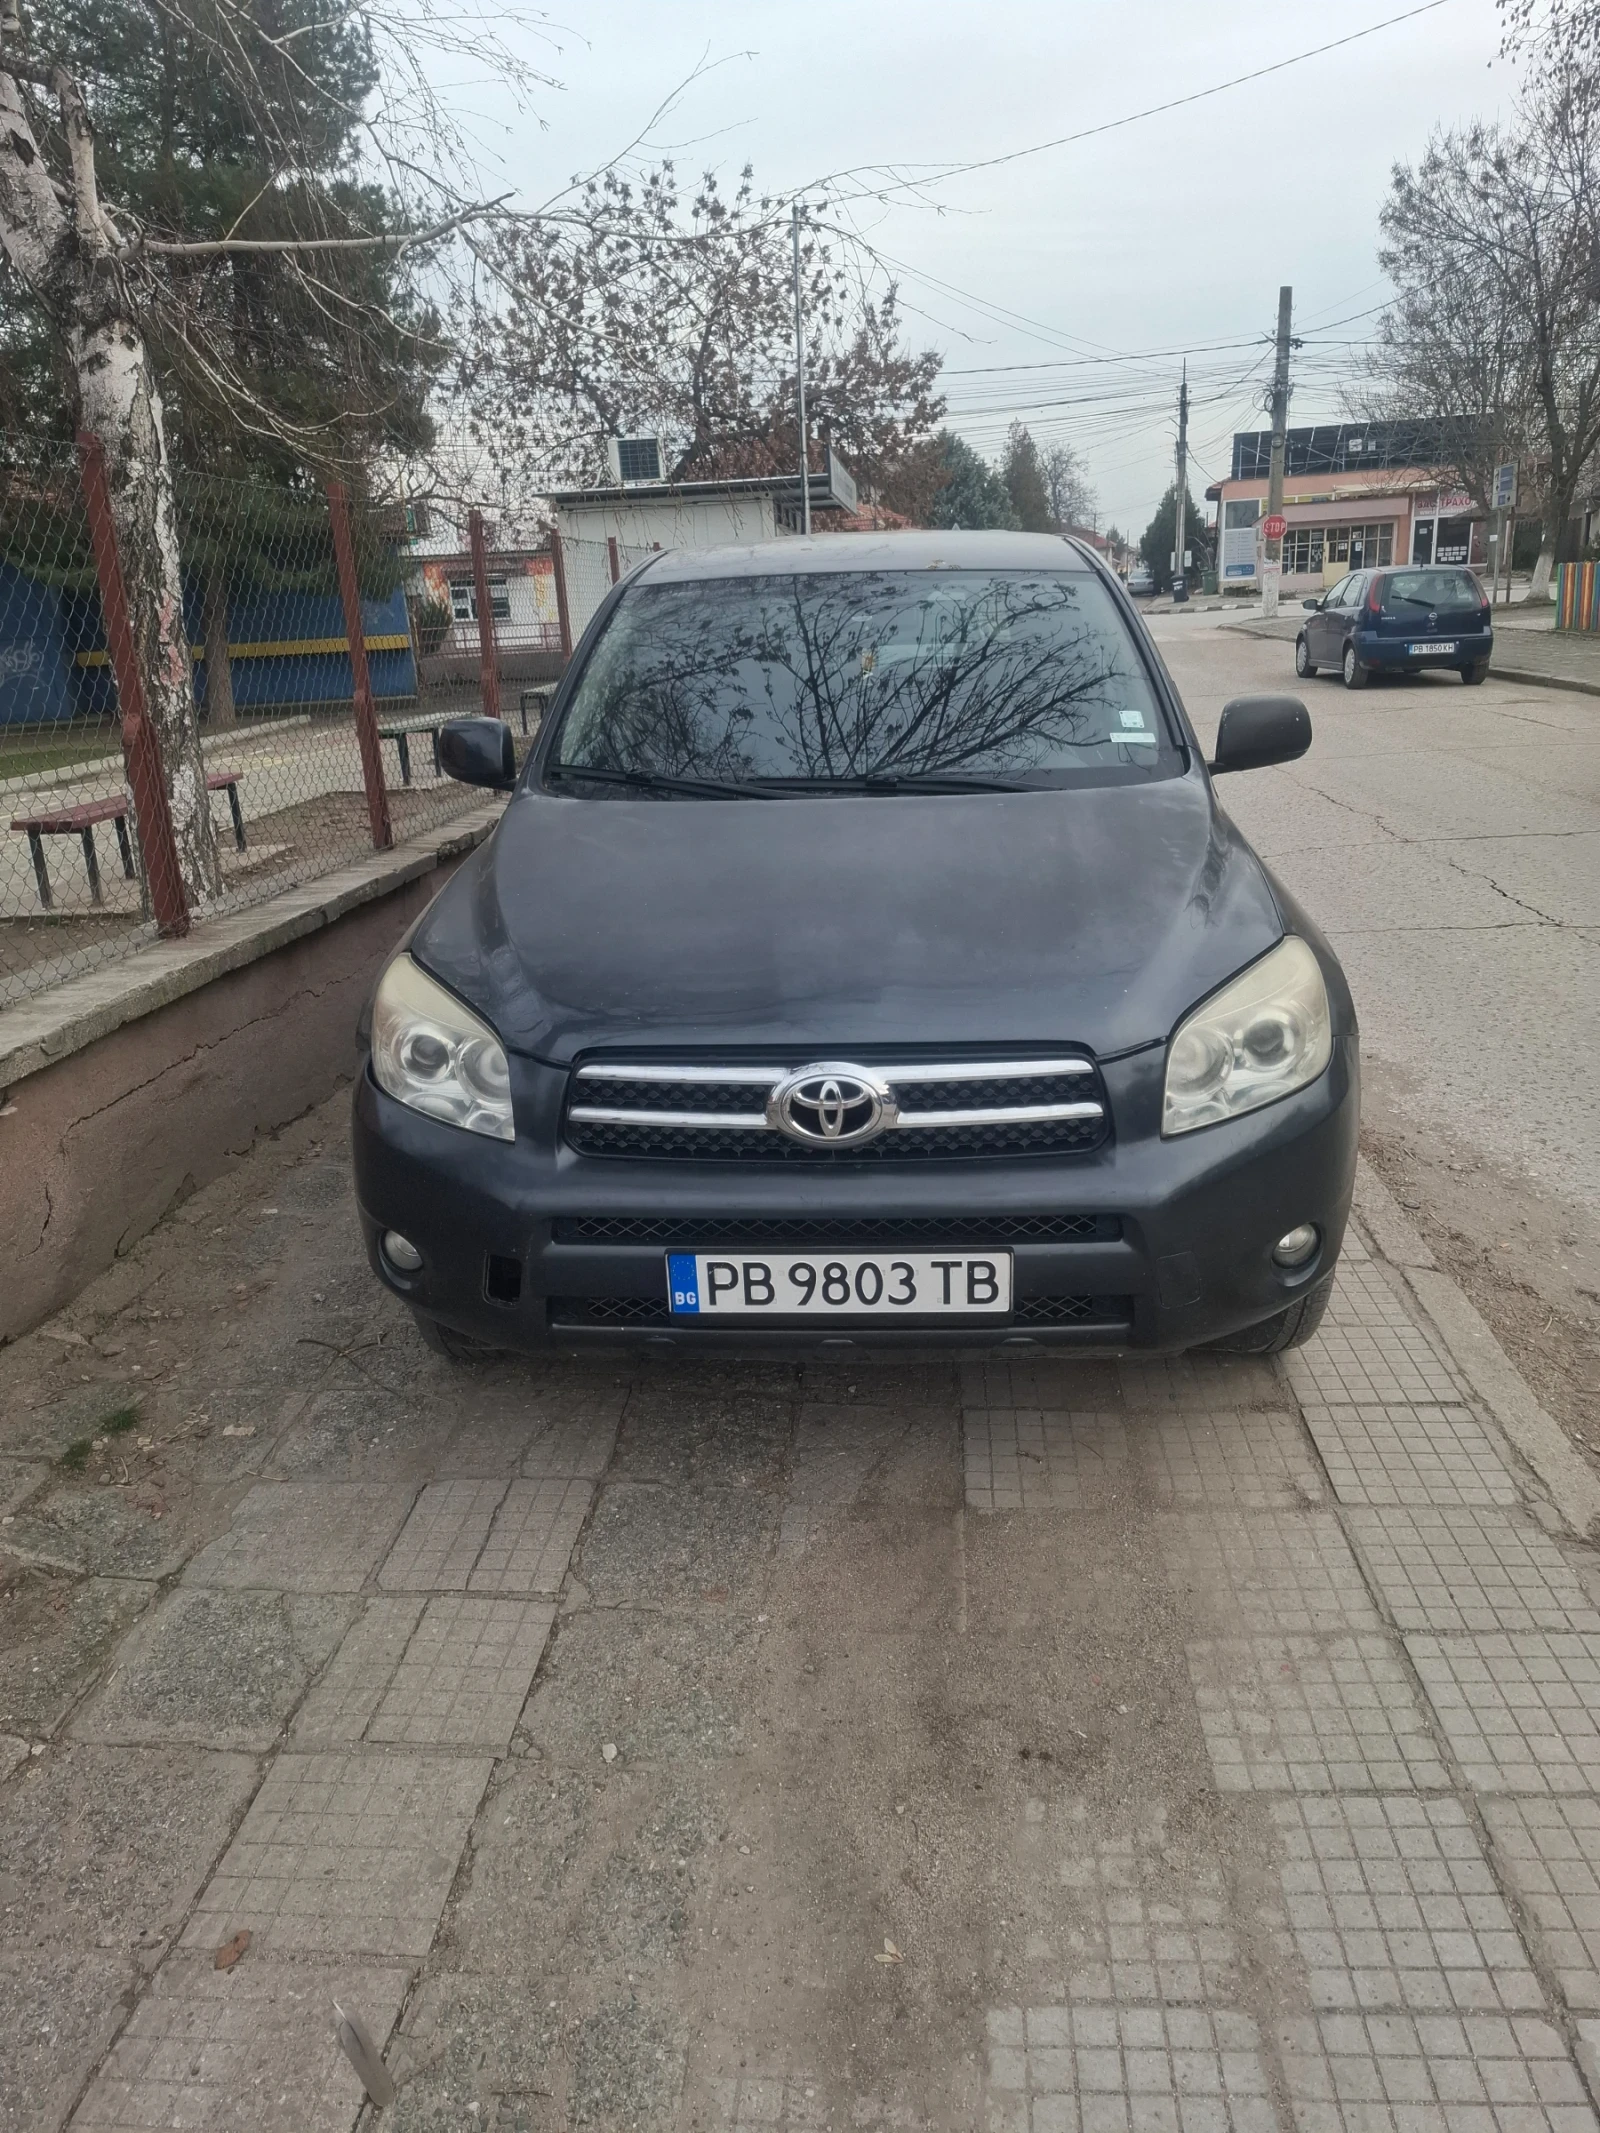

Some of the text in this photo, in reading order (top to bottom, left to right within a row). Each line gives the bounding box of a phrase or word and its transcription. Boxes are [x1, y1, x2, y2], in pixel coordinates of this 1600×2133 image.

[1264, 522, 1286, 533] STOP
[1413, 645, 1424, 653] PB
[1426, 644, 1442, 652] 1850
[706, 1259, 1000, 1307] PB 9803 TB
[674, 1292, 697, 1306] BG
